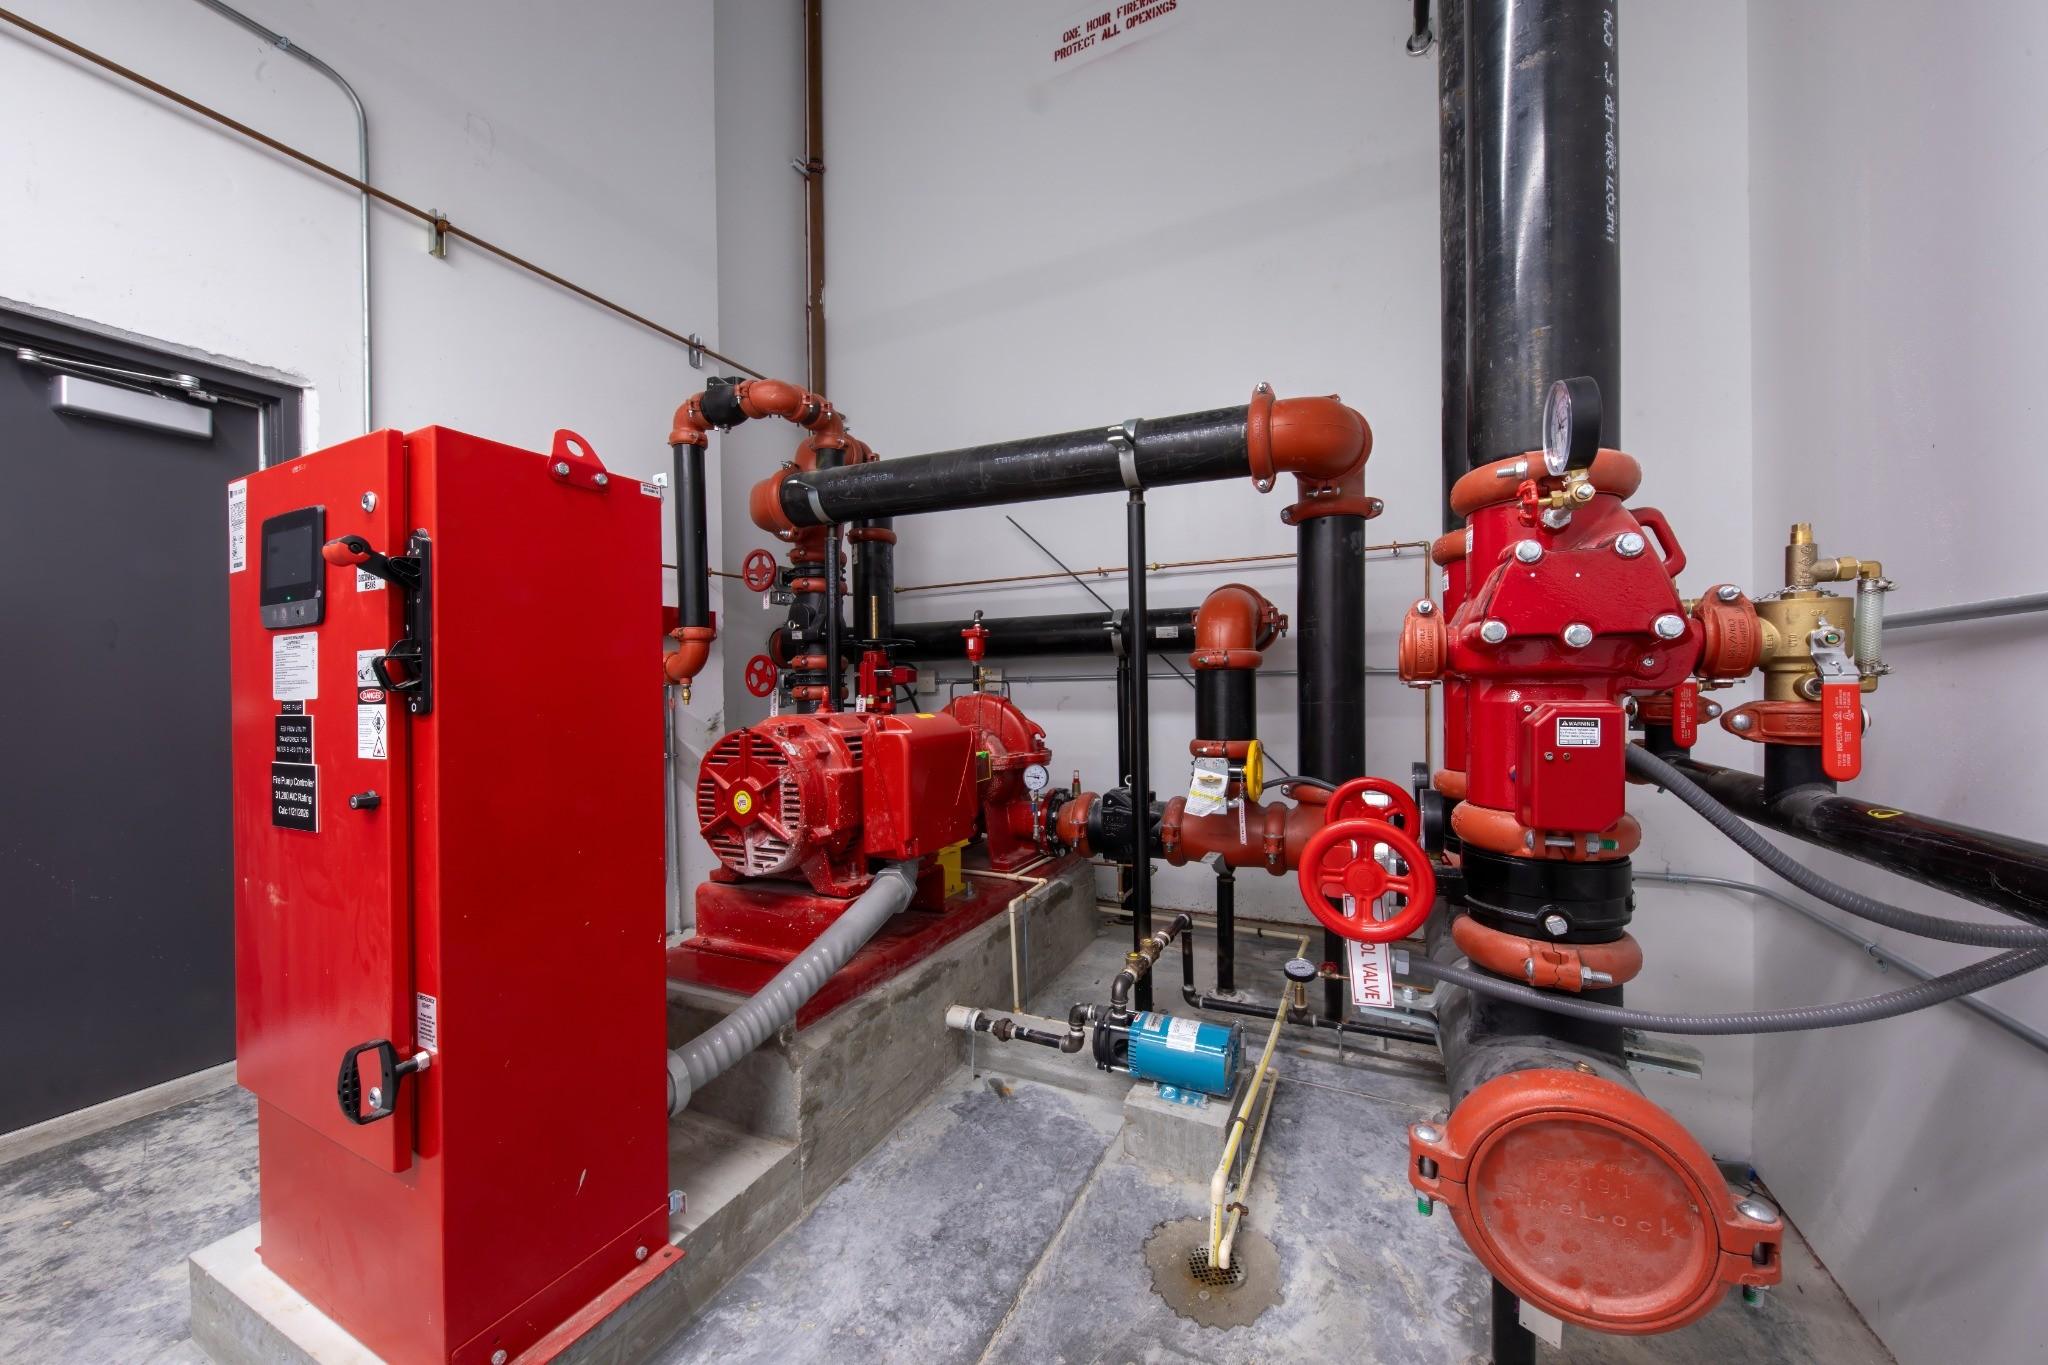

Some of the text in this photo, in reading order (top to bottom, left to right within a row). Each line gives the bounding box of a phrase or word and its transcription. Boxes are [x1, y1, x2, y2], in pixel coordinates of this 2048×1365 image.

[1054, 0, 1177, 62] PROTECT ALL OPENINGS
[1063, 25, 1081, 43] ONE
[1086, 12, 1111, 33] HOUR
[362, 691, 382, 700] DANGER
[272, 775, 315, 788] Fire Pump Controller
[297, 793, 312, 805] Rating
[1362, 962, 1381, 1000] VALVE
